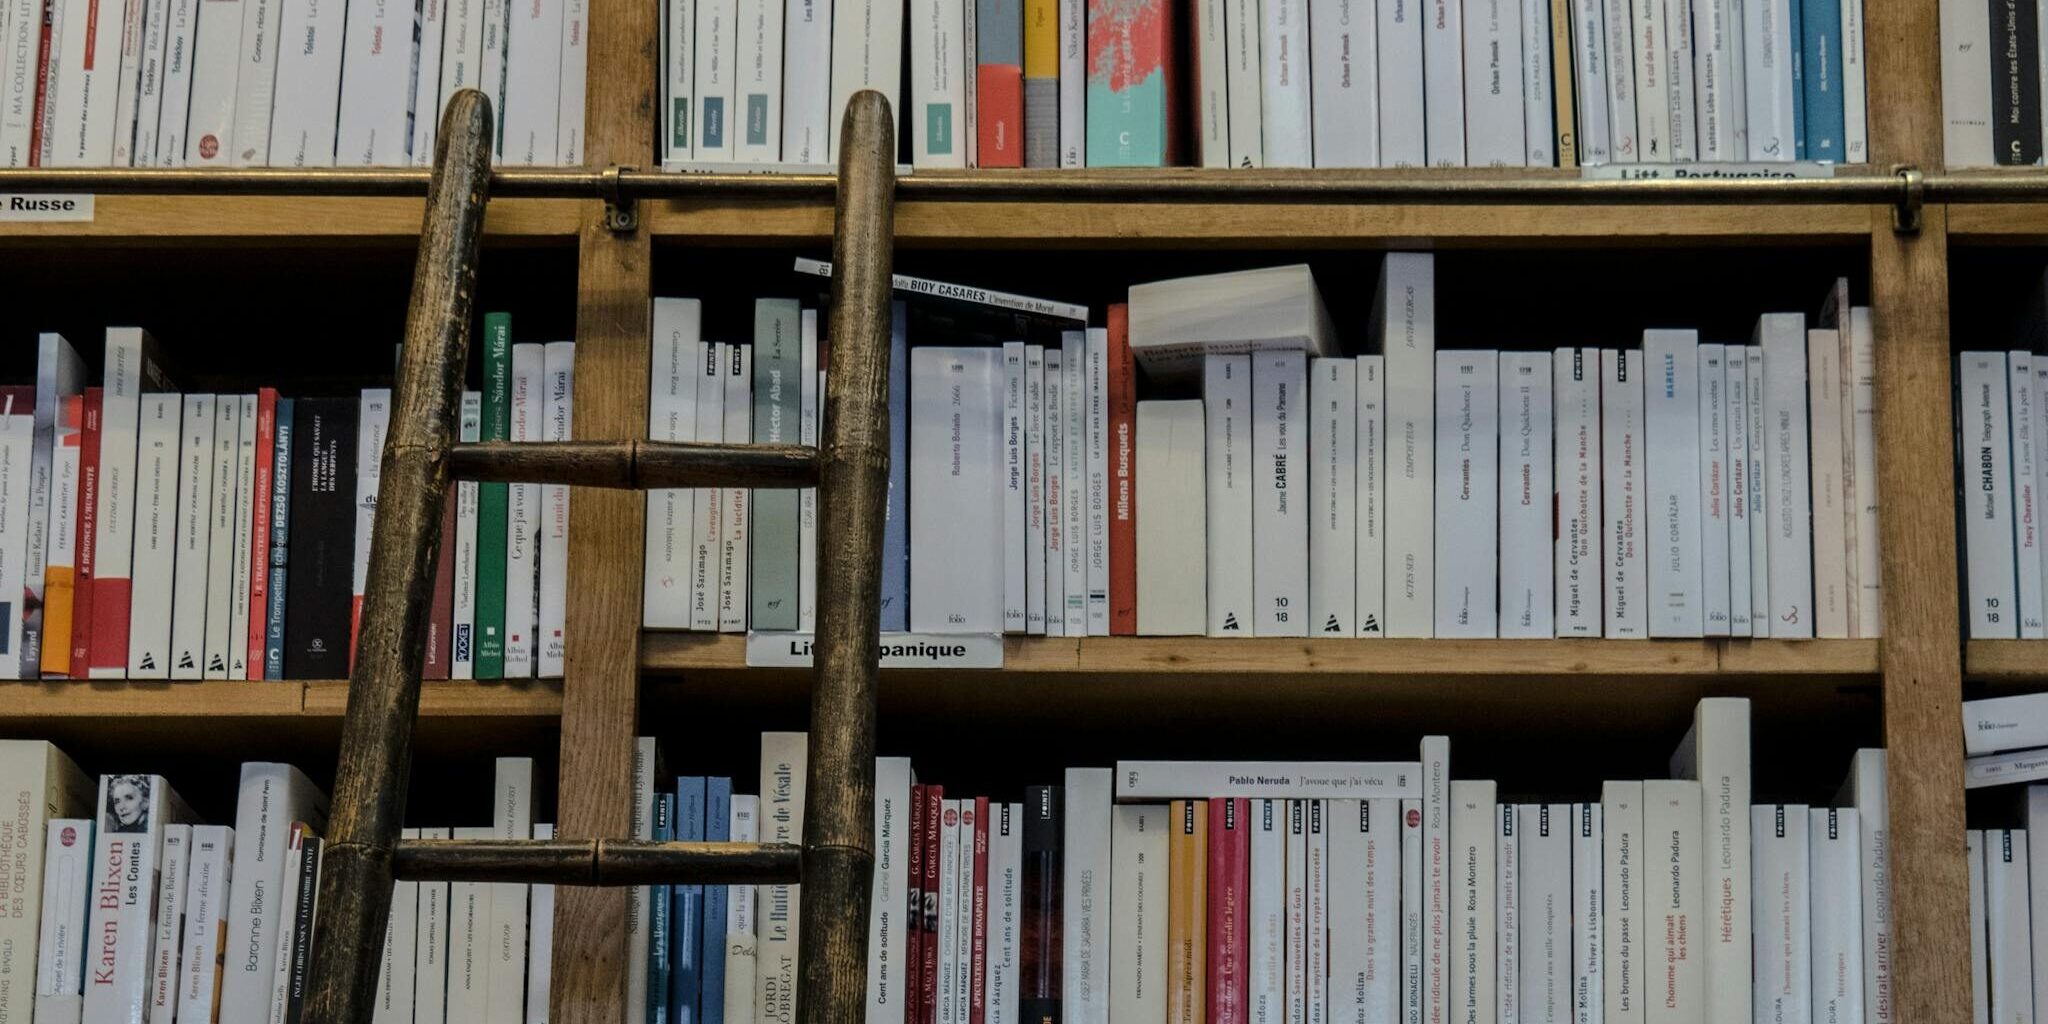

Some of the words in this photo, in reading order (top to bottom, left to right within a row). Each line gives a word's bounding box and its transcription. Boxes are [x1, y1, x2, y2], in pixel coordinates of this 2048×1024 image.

[1341, 34, 1350, 61] Pamuk
[1586, 20, 1596, 49] Amado
[2006, 11, 2017, 58] États-Unis
[15, 21, 29, 93] COLLECTION
[172, 36, 184, 74] Tchekhov
[1588, 51, 1597, 75] Jorge
[1646, 52, 1654, 63] de
[2009, 60, 2017, 74] les
[145, 58, 156, 96] Tchekhov
[1341, 63, 1350, 88] Orhan
[1646, 64, 1655, 77] cul
[1646, 79, 1655, 87] Le
[2010, 76, 2018, 104] contre
[14, 97, 23, 115] MA
[2011, 107, 2019, 123] Moi
[11, 197, 75, 211] Russe
[910, 279, 935, 293] BIOY
[938, 284, 986, 302] CASARES
[989, 294, 1024, 308] L'invention
[1025, 302, 1034, 310] de
[1034, 302, 1054, 313] Morel
[1665, 353, 1674, 398] MARELLE
[952, 386, 960, 406] 2666
[1008, 377, 1018, 409] Fictions
[1980, 384, 1990, 408] Avenue
[951, 414, 960, 442] Bolaño
[1009, 416, 1019, 445] Borges
[1981, 409, 1992, 442] Telegraph
[273, 426, 289, 493] KOSZTOLÁNYI
[952, 444, 961, 476] Roberto
[1009, 448, 1018, 464] Luis
[1117, 423, 1130, 477] Busquets
[1009, 466, 1019, 490] Jorge
[1981, 446, 1993, 491] CHABON
[257, 468, 269, 523] CLEPTOMANE
[1117, 480, 1129, 520] Milena
[1985, 493, 1995, 519] Michael
[255, 526, 267, 582] TRADUCTEUR
[1570, 518, 1578, 565] Cervantes
[1615, 520, 1624, 567] Cervantes
[697, 544, 706, 589] Saramago
[723, 540, 734, 587] Saramago
[1570, 568, 1578, 580] de
[1616, 571, 1624, 582] de
[270, 568, 285, 625] Trompettiste
[695, 591, 705, 611] José
[722, 590, 732, 610] José
[1275, 597, 1288, 607] 10
[1570, 584, 1580, 616] Miguel
[1616, 586, 1626, 618] Miguel
[1986, 598, 1999, 608] 10
[1275, 612, 1288, 623] 18
[1987, 613, 1999, 623] 18
[26, 631, 37, 661] Fayard
[268, 627, 280, 638] Le
[456, 624, 470, 662] POCKET
[790, 641, 815, 656] Lit
[880, 642, 966, 659] panique
[771, 763, 792, 803] Vésale
[1229, 775, 1255, 786] Pablo
[1257, 775, 1290, 786] Neruda
[1298, 775, 1329, 787] J'avoue
[1331, 776, 1347, 788] que
[1349, 776, 1362, 788] j'ai
[1364, 776, 1383, 787] vécu
[1431, 761, 1441, 804] Montero
[1719, 776, 1731, 815] Padura
[17, 791, 31, 848] CABOSSÉS
[772, 807, 789, 822] de
[1432, 807, 1441, 829] Rosa
[1432, 837, 1441, 865] revoir
[1620, 833, 1630, 865] Padura
[1671, 831, 1681, 863] Padura
[1720, 818, 1731, 870] Leonardo
[1873, 830, 1885, 869] Padura
[99, 840, 124, 910] Blixen
[127, 842, 141, 881] Contes
[165, 858, 177, 890] Babette
[1432, 867, 1441, 877] te
[1467, 846, 1477, 887] Montero
[125, 885, 137, 905] Les
[198, 862, 211, 899] africaine
[1003, 868, 1013, 907] solitude
[1620, 867, 1629, 911] Leonardo
[1671, 866, 1681, 909] Leonardo
[13, 898, 24, 918] DES
[165, 892, 174, 903] de
[250, 880, 265, 914] Blixen
[1432, 880, 1443, 913] jamais
[1467, 889, 1477, 911] Rosa
[1588, 889, 1597, 931] Lisbonne
[1720, 877, 1733, 943] Hérétiques
[1873, 871, 1886, 924] Leonardo
[162, 905, 174, 927] festin
[196, 900, 207, 924] ferme
[974, 886, 984, 937] BONAPARTE
[1004, 912, 1012, 923] de
[1431, 915, 1443, 935] plus
[161, 929, 171, 940] Le
[194, 925, 205, 936] La
[769, 926, 788, 941] Le
[1004, 927, 1012, 943] ans
[1467, 917, 1478, 940] pluie
[1621, 917, 1631, 943] passé
[1665, 915, 1675, 945] aimait
[1677, 915, 1687, 945] chiens
[94, 920, 118, 986] Karen
[192, 945, 203, 972] Blixen
[245, 918, 262, 972] Baronne
[974, 940, 983, 951] DE
[1002, 946, 1011, 968] Cent
[1431, 952, 1441, 965] de
[1433, 938, 1441, 950] ne
[1467, 943, 1476, 951] la
[1588, 943, 1597, 973] L'hiver
[1620, 945, 1629, 958] du
[1666, 947, 1676, 962] qui
[1677, 946, 1687, 960] les
[1875, 932, 1887, 972] arriver
[158, 950, 169, 978] Blixen
[1621, 960, 1629, 995] brumes
[156, 980, 167, 1007] Karen
[189, 974, 200, 1000] Karen
[765, 976, 779, 1020] JORDI
[992, 964, 1002, 1005] Márquez
[1355, 972, 1364, 1004] Molina
[1431, 967, 1441, 1004] ridicule
[1467, 976, 1476, 1007] larmes
[1579, 976, 1588, 1008] Molina
[1666, 965, 1676, 1008] L'homme
[1875, 975, 1889, 1019] désirait
[1621, 997, 1629, 1012] Les
